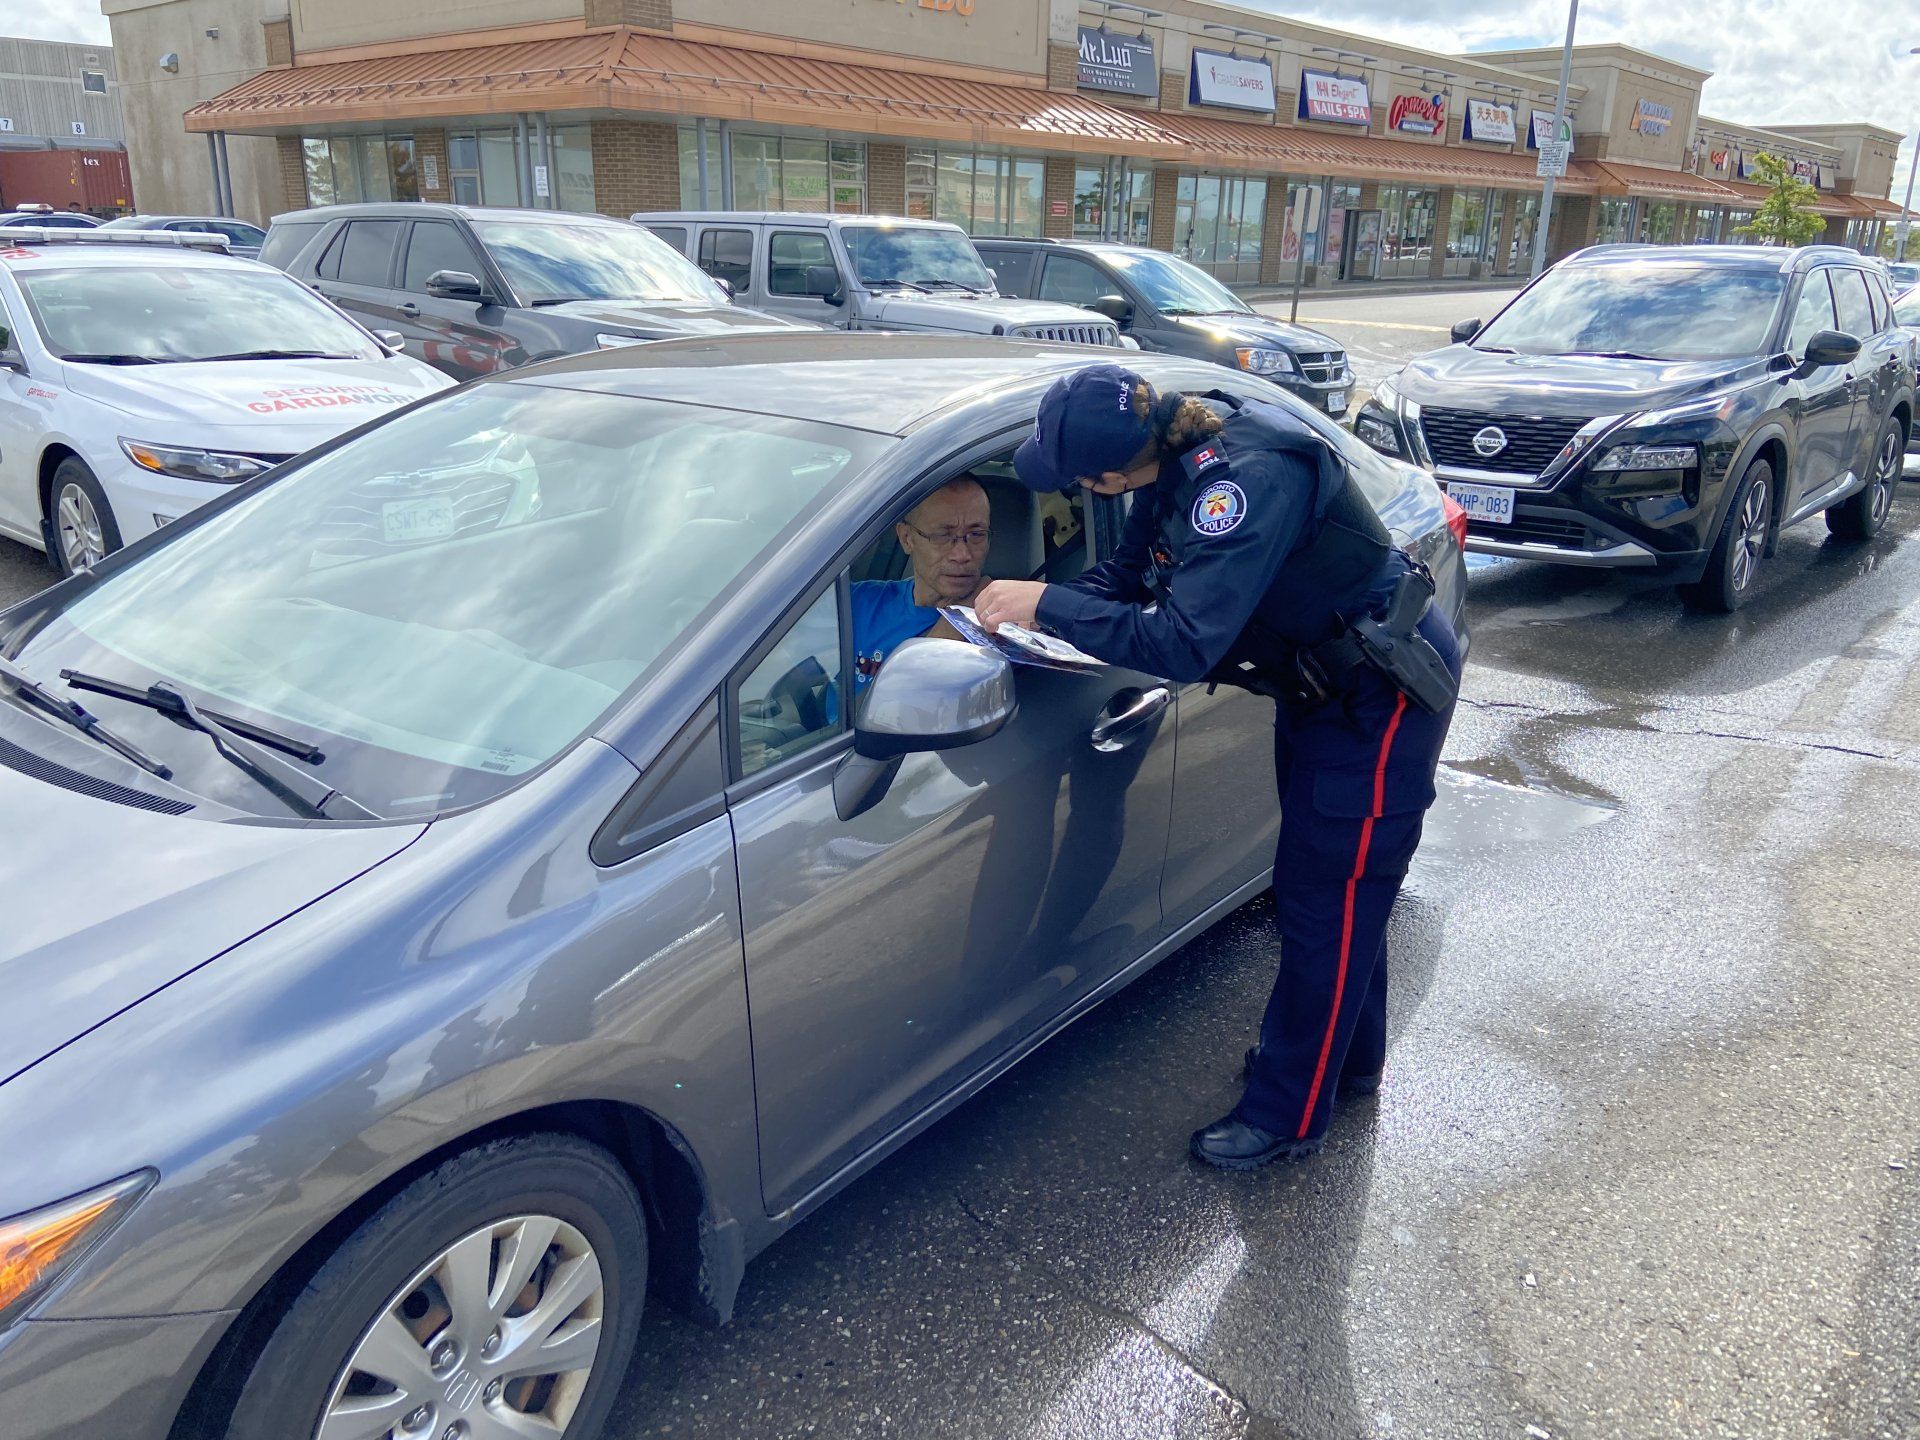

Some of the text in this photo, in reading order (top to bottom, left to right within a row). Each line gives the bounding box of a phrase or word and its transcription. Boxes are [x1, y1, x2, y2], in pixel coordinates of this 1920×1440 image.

[1313, 100, 1366, 120] NAILS SPA
[3, 119, 9, 130] 7
[75, 123, 82, 134] 8
[262, 386, 392, 398] SECURITY
[248, 394, 415, 413] GARDAWOR
[1475, 438, 1503, 446] NISSAN
[1198, 484, 1236, 502] TORONTO
[1486, 496, 1509, 514] 083
[1203, 517, 1234, 532] POLICE
